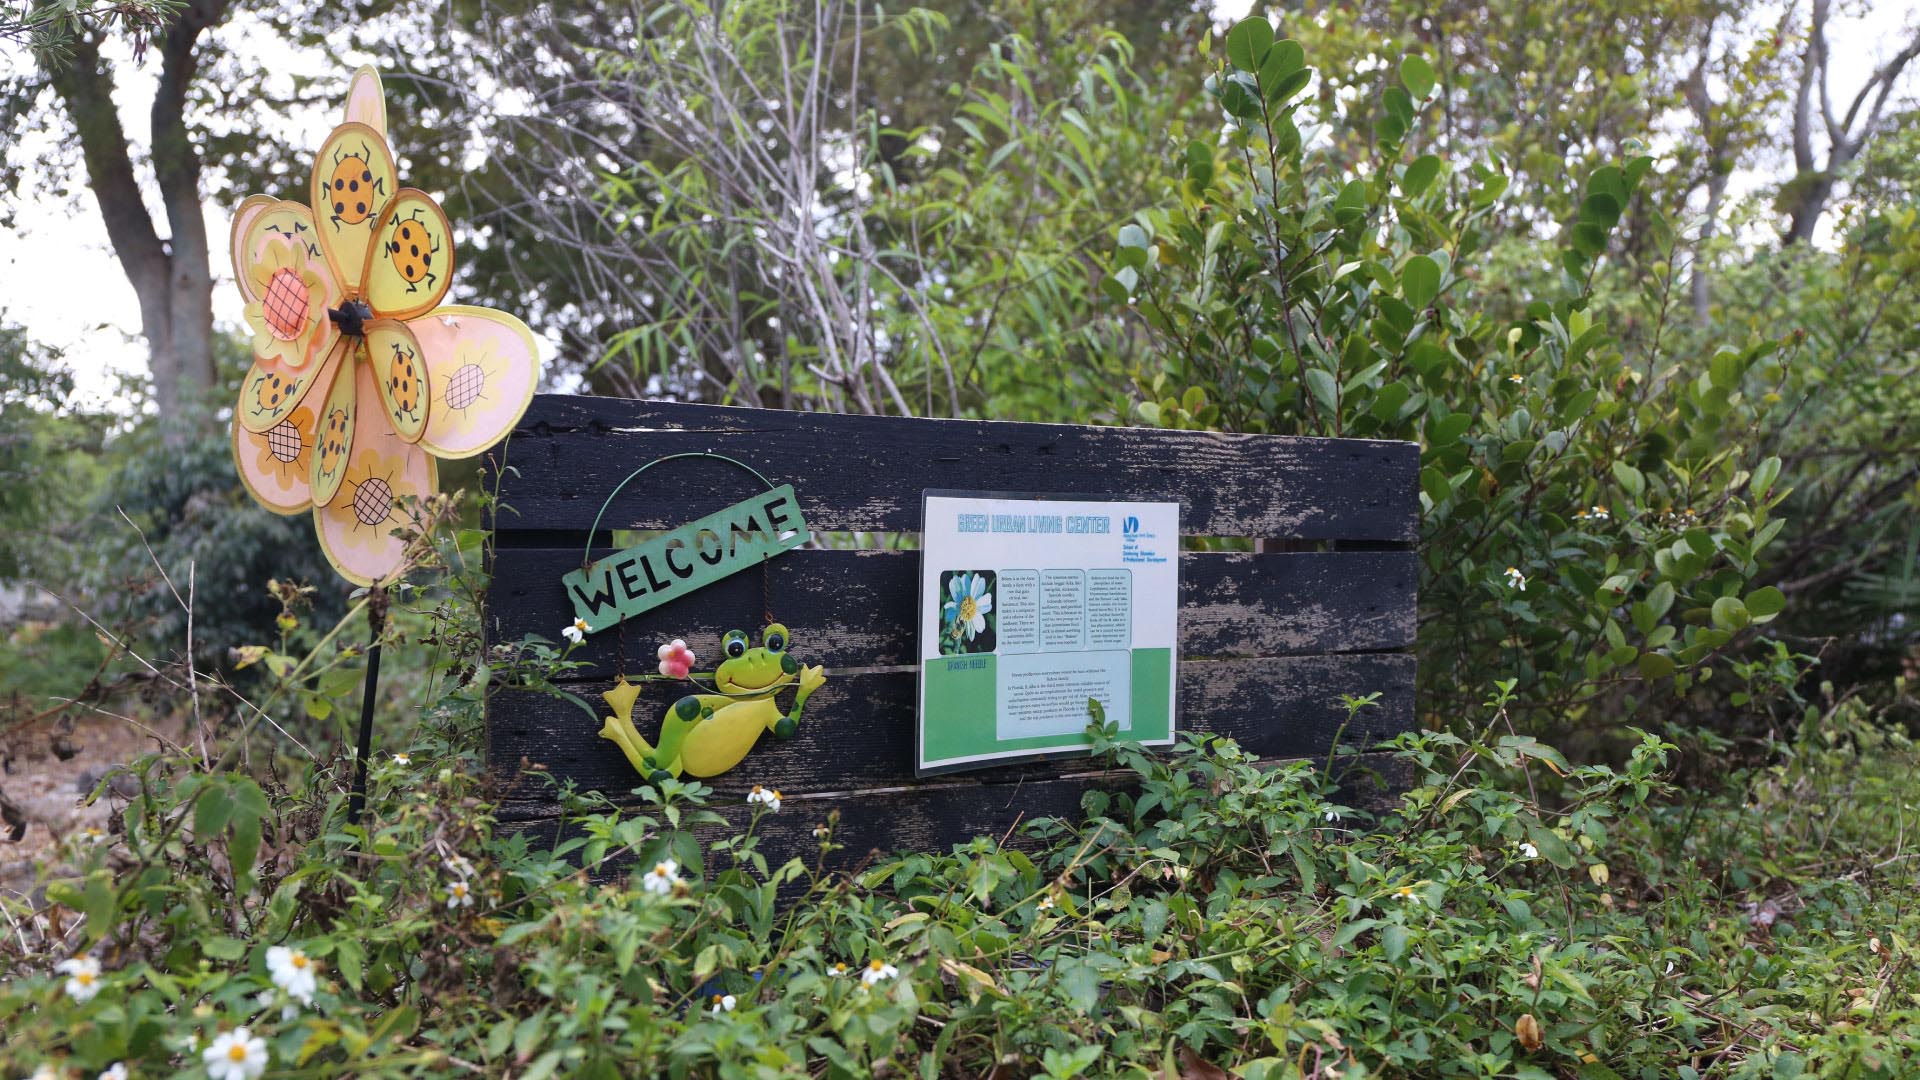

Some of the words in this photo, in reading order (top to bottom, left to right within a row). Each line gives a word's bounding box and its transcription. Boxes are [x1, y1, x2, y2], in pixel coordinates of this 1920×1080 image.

[573, 497, 799, 616] WELCOME
[958, 514, 989, 533] GREEN
[992, 514, 1025, 533] URBAN
[1028, 515, 1062, 533] LIVING
[1066, 516, 1110, 534] CENTER
